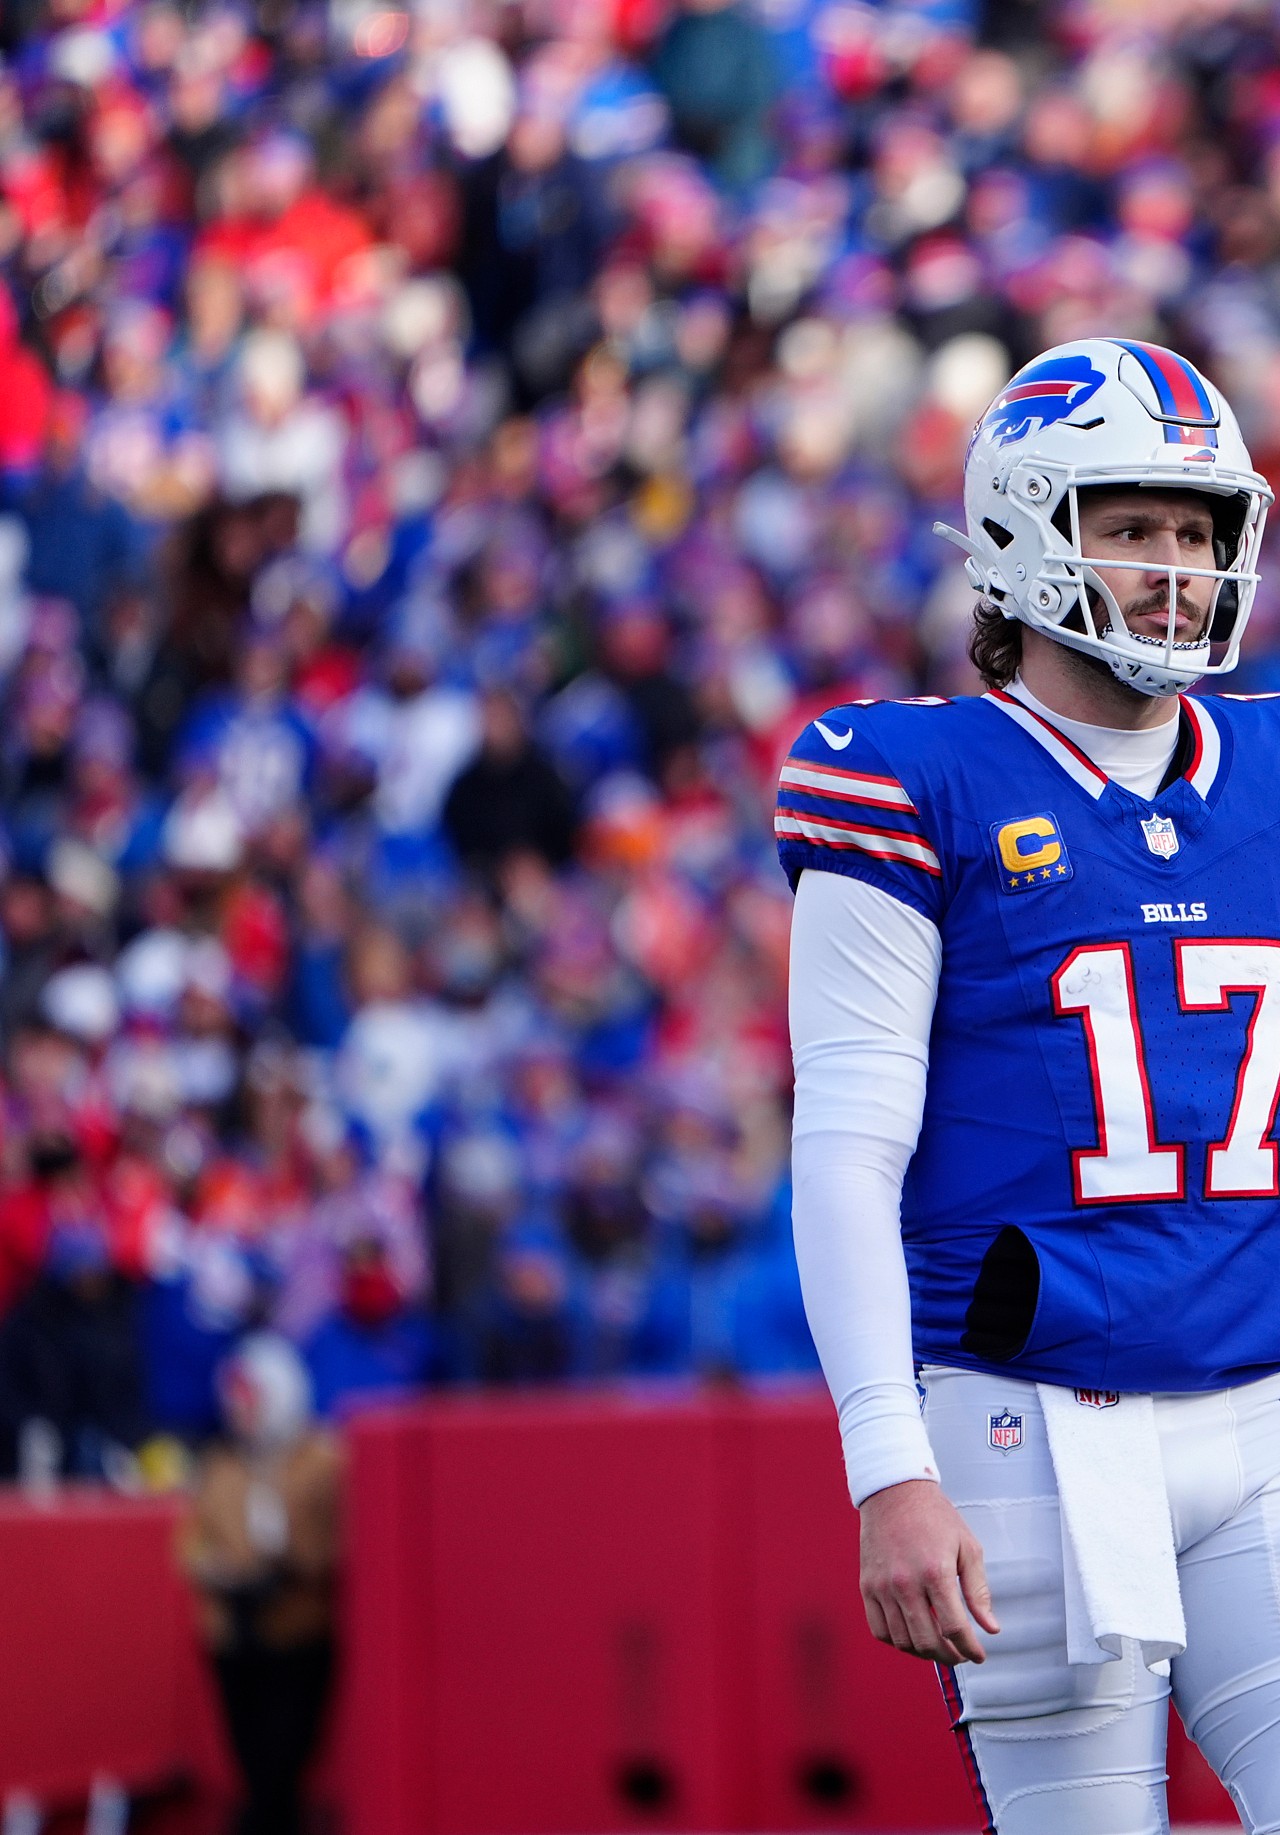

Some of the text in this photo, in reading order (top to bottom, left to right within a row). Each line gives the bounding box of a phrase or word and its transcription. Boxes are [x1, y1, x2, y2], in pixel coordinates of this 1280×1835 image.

[998, 816, 1061, 872] C
[1152, 834, 1175, 850] NFL
[1140, 903, 1208, 923] BILLS
[1079, 1389, 1116, 1405] NFL
[993, 1428, 1019, 1446] NFL
